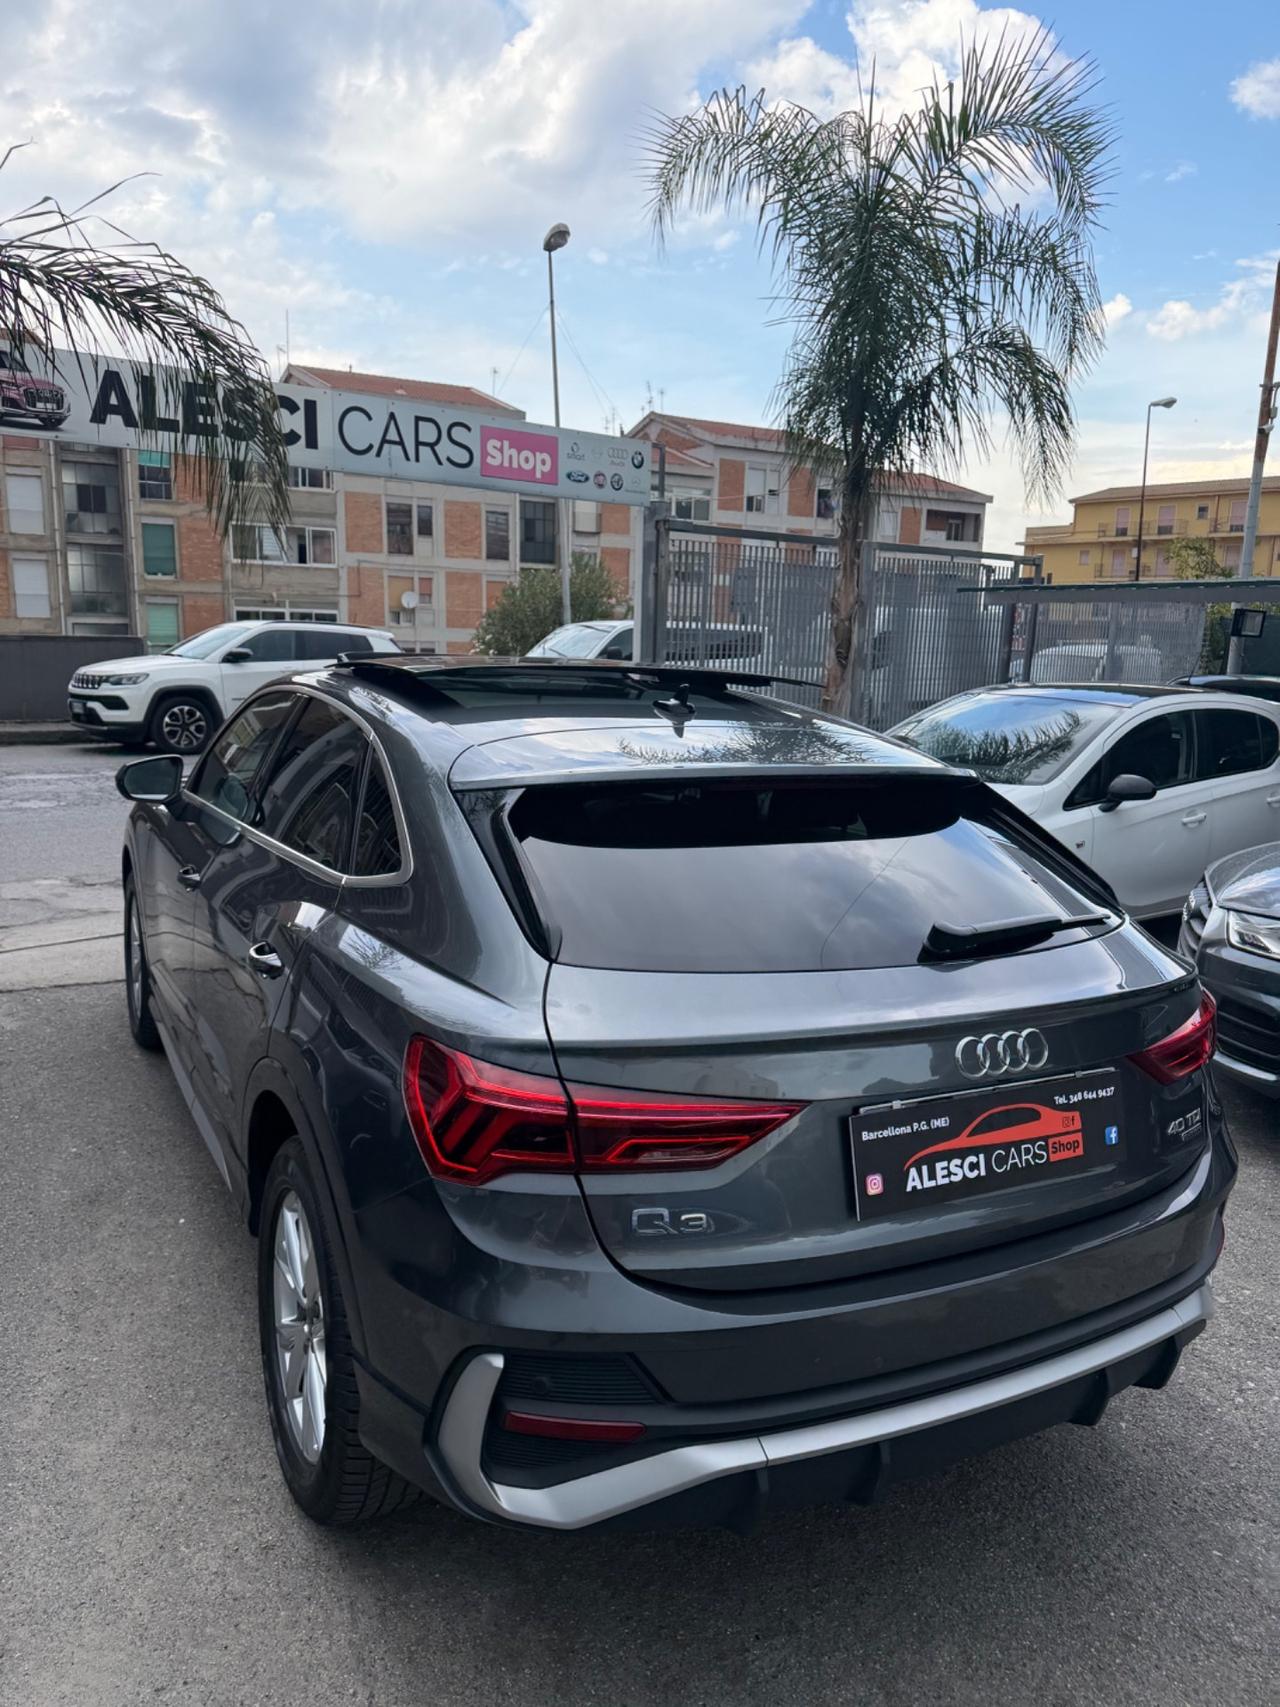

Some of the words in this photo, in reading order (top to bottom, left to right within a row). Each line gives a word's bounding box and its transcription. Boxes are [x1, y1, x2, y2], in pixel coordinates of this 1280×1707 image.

[338, 405, 474, 469] CARS
[486, 438, 552, 479] Shop
[862, 1126, 912, 1141] Barcellona
[913, 1120, 929, 1132] P.G.
[930, 1116, 950, 1129] (ME)
[905, 1153, 986, 1192] ALESCI
[991, 1141, 1047, 1173] CARS
[1051, 1139, 1080, 1155] Shop
[631, 1207, 707, 1235] Q3
